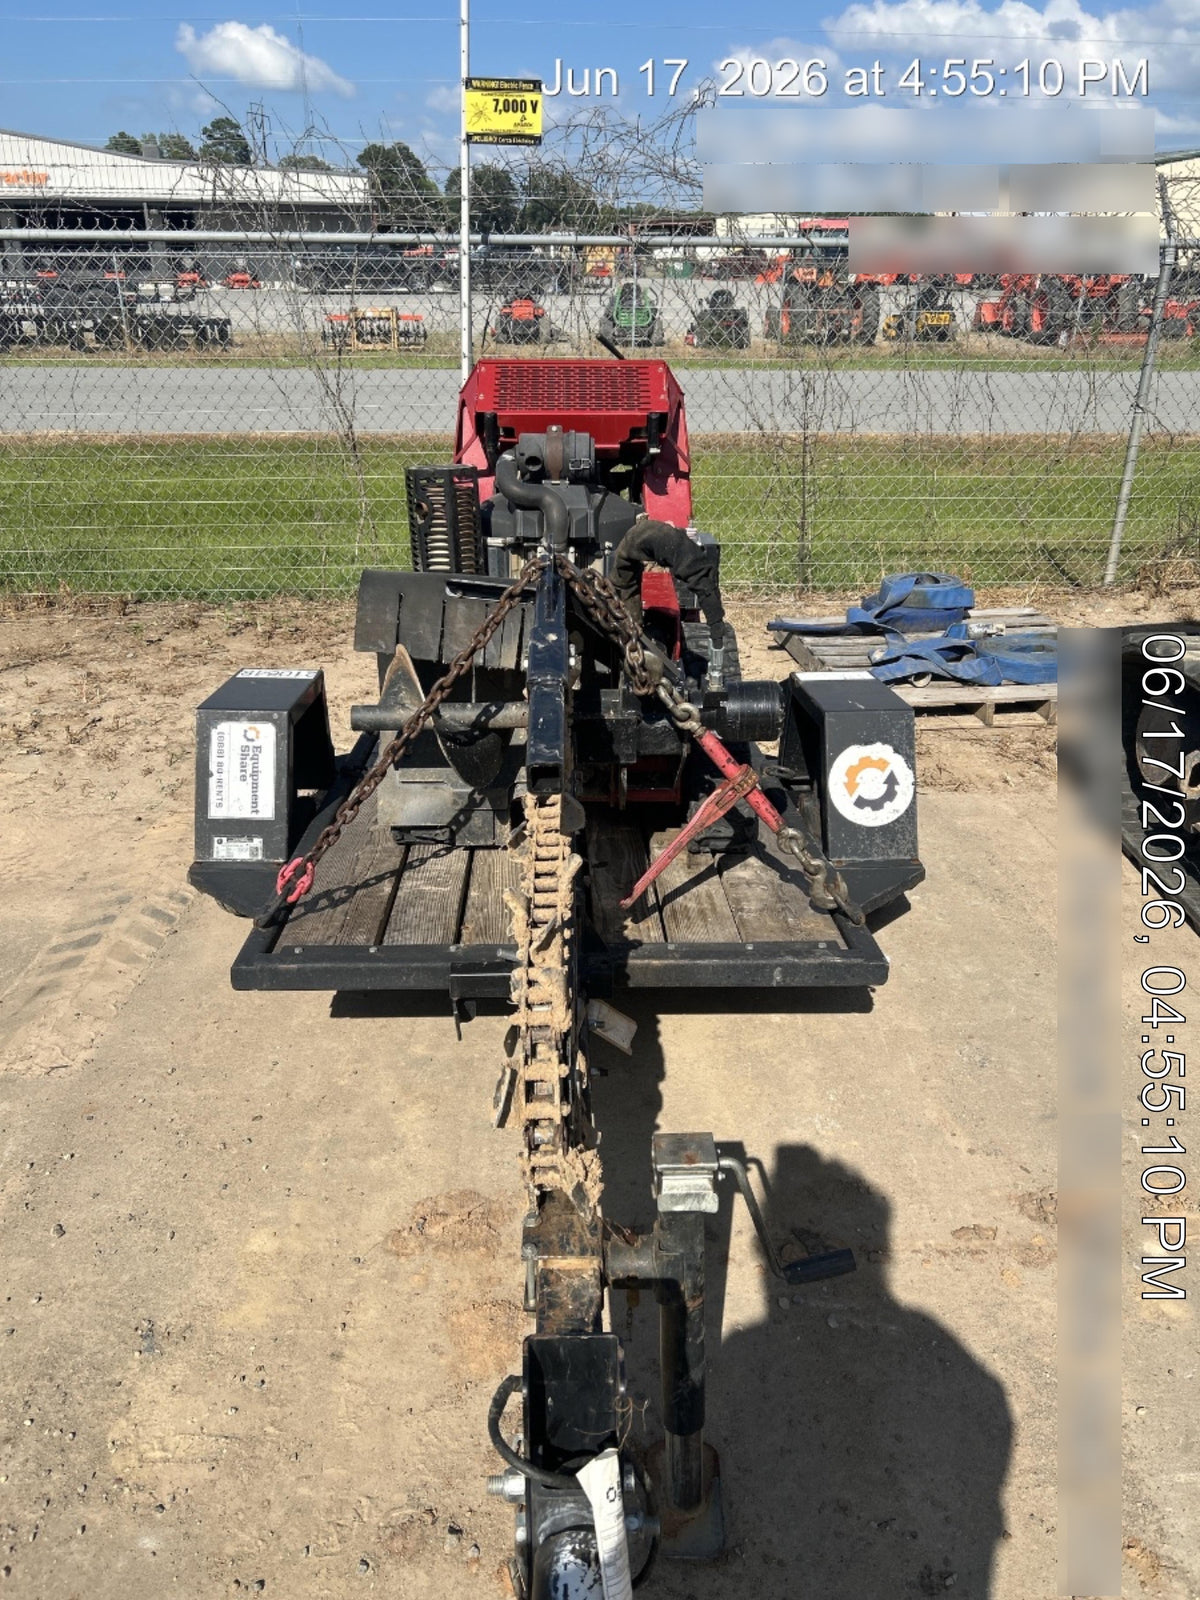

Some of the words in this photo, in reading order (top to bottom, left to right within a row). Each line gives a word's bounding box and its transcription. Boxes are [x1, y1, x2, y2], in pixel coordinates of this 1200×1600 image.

[493, 98, 527, 115] 7,000
[530, 100, 538, 114] V
[240, 745, 250, 782] Share
[249, 745, 262, 815] Equipment
